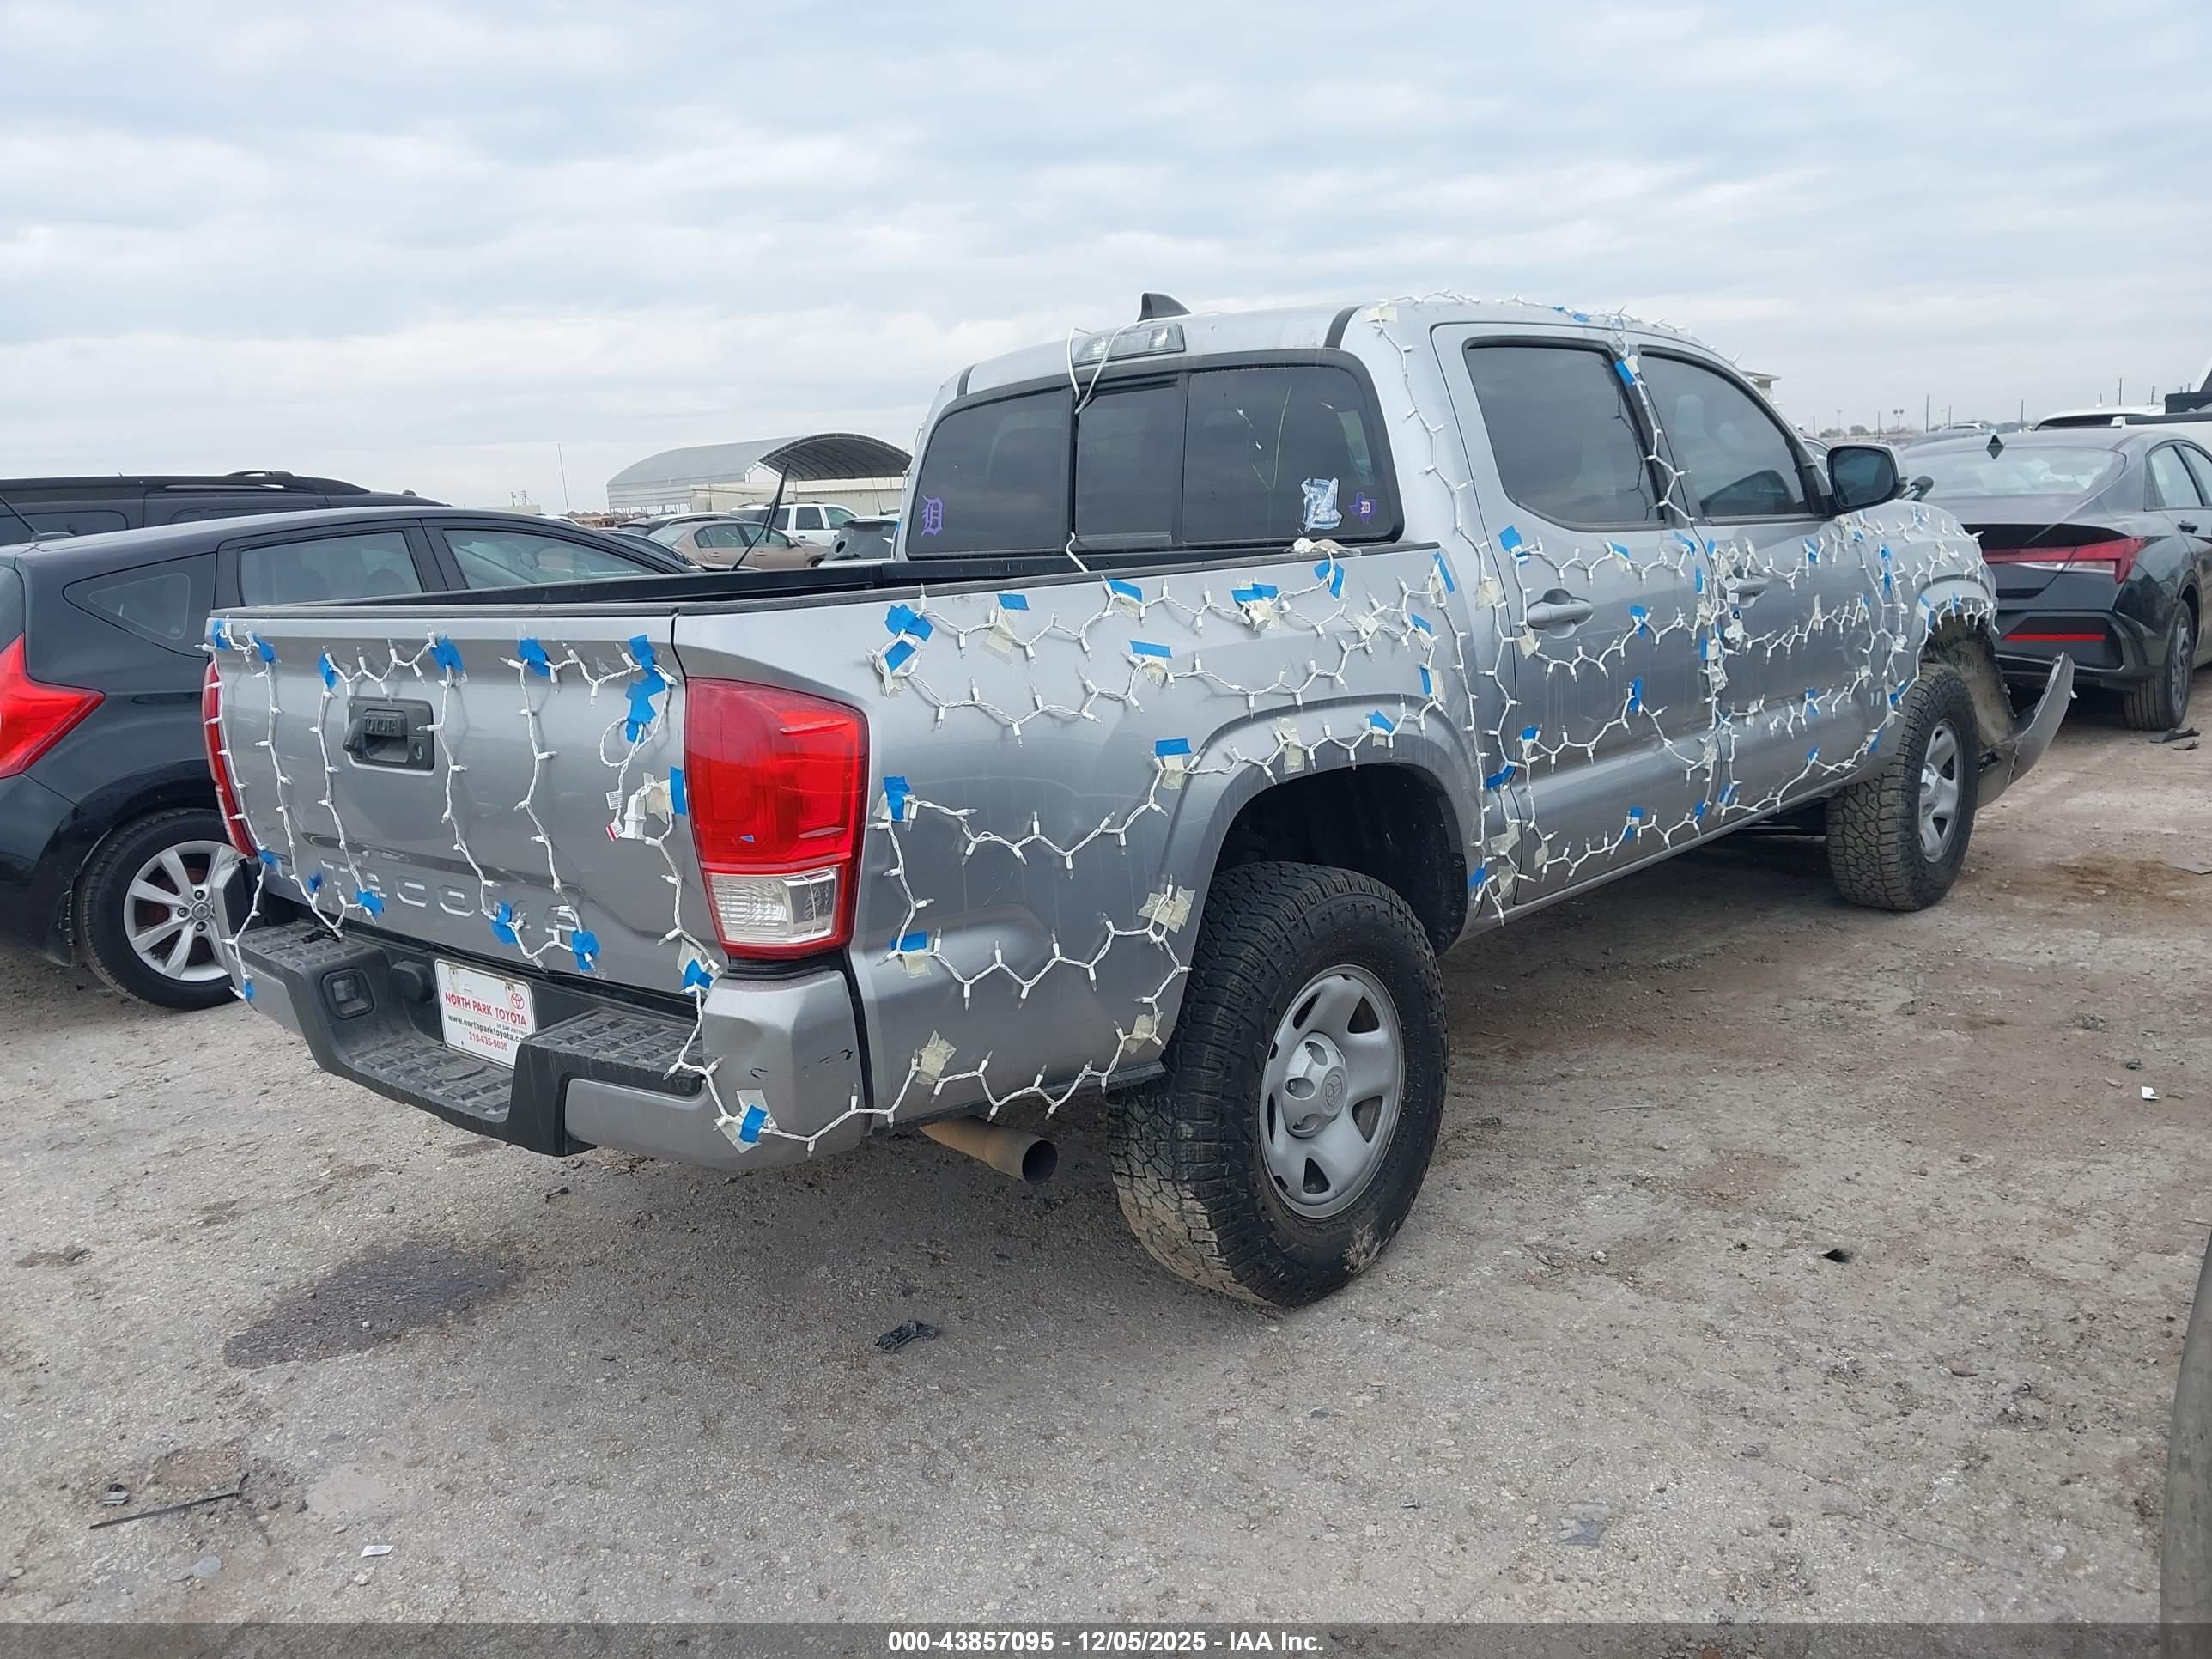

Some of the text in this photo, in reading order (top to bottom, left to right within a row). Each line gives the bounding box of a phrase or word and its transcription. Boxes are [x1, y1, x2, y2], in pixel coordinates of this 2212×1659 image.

[445, 992, 527, 1027] NORTH PARK TOYOTA
[447, 1013, 523, 1044] www.northparktoyota.co
